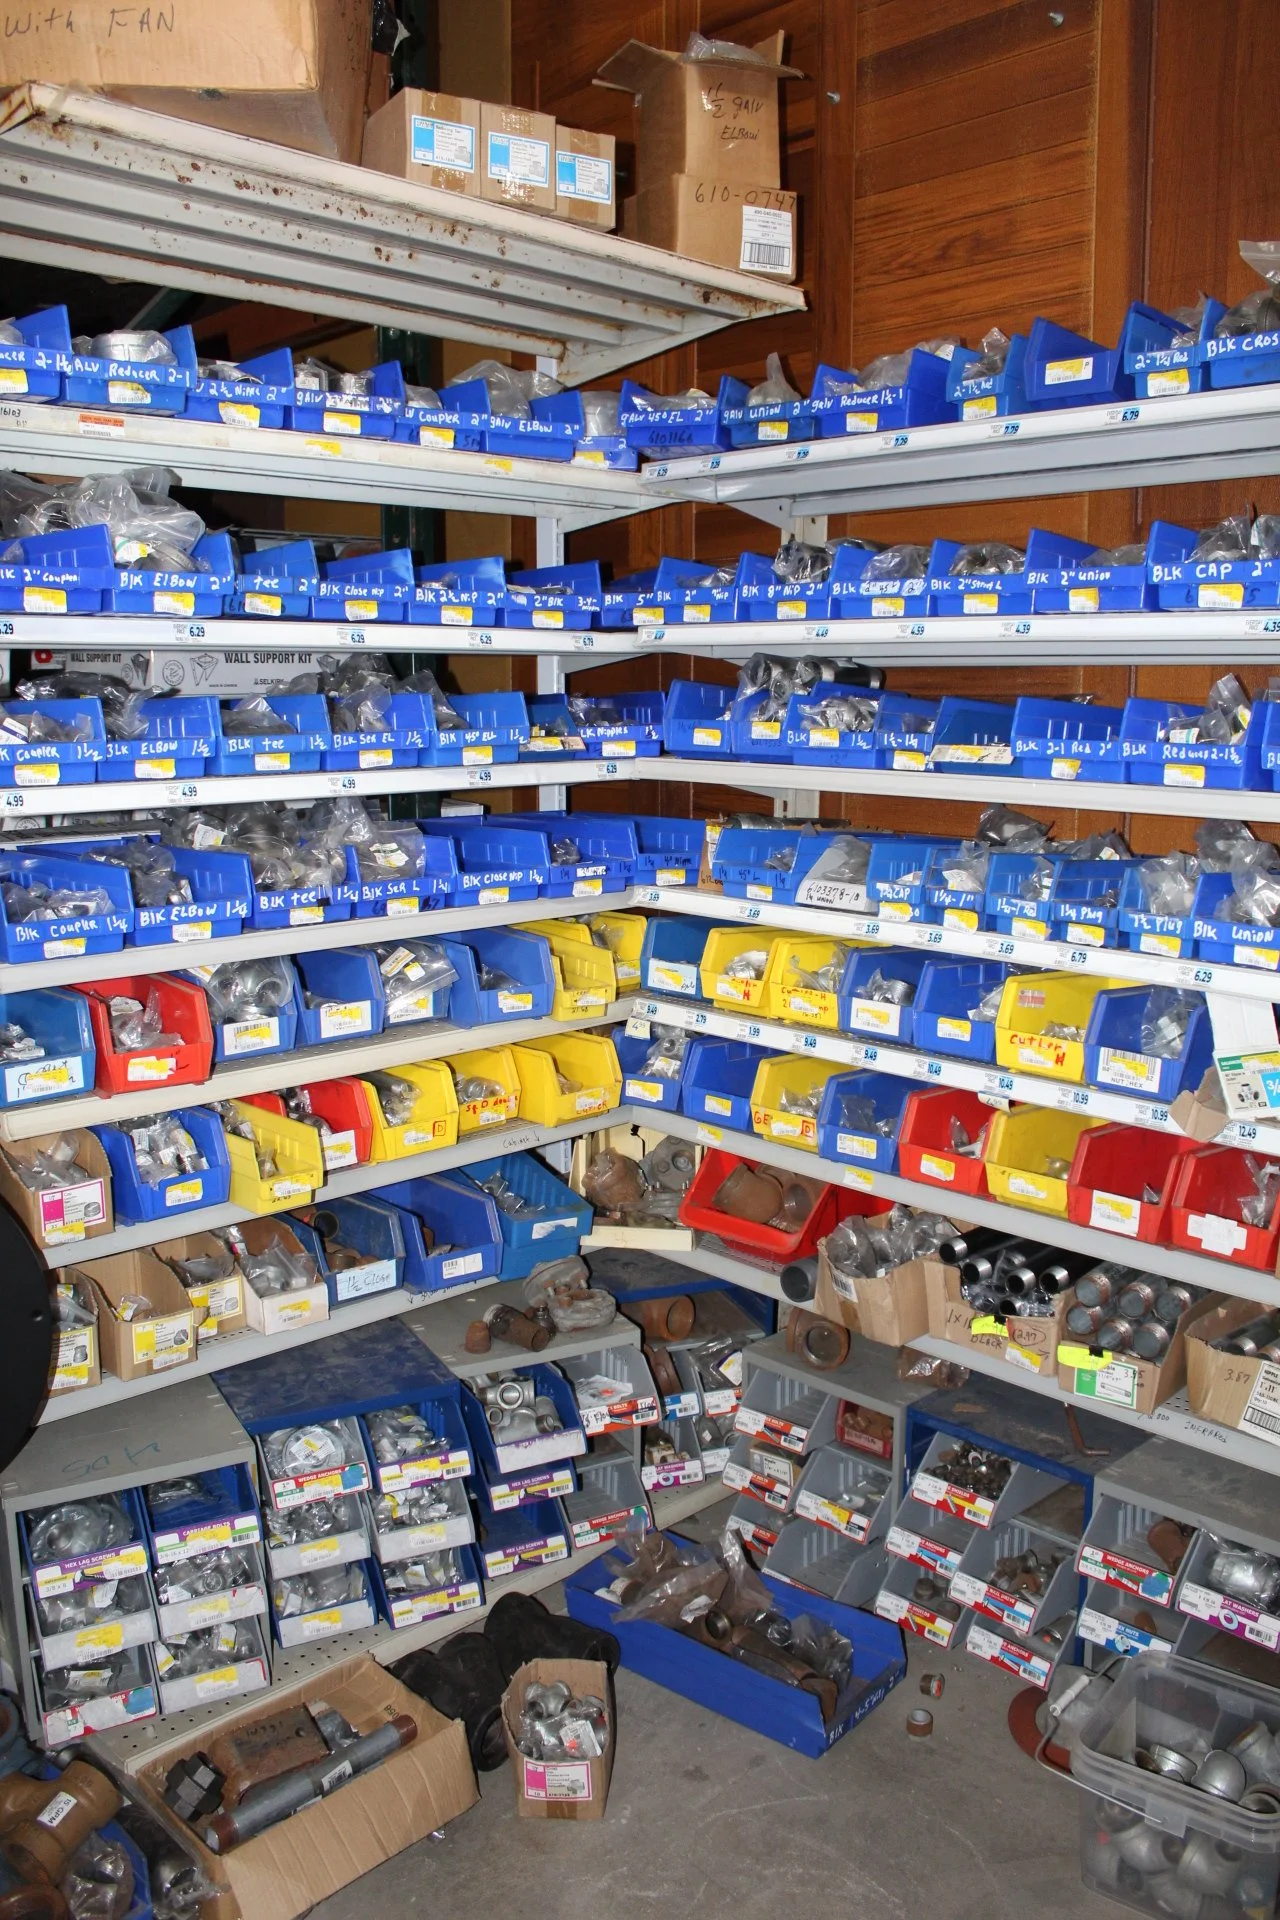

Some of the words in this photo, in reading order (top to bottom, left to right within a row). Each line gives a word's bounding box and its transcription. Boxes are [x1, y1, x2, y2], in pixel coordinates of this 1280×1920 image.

[4, 8, 75, 38] With
[108, 2, 176, 38] FAN
[1206, 338, 1237, 358] BLK
[1121, 409, 1139, 422] 6.79
[1196, 563, 1233, 579] CAP
[189, 626, 205, 637] 6.29
[816, 627, 828, 638] 4.49
[911, 625, 925, 636] 4.59
[1016, 623, 1031, 634] 4.39
[1263, 622, 1280, 632] 4.39
[351, 633, 365, 644] 6.29
[479, 634, 492, 645] 6.29
[70, 652, 84, 662] WALL
[86, 652, 111, 663] SUPPORT
[112, 653, 121, 663] KIT
[224, 652, 251, 664] WALL
[254, 652, 295, 664] SUPPORT
[298, 653, 312, 664] KIT
[787, 731, 807, 744] BLK
[1016, 740, 1038, 753] BLK
[1123, 742, 1146, 756] BLK
[479, 771, 491, 782] 4.99
[342, 777, 356, 790] 4.99
[182, 785, 197, 797] 4.99
[6, 794, 23, 807] 4.99
[748, 908, 760, 918] 3.69
[866, 924, 879, 935] 3.69
[928, 932, 941, 943] 3.69
[998, 943, 1014, 954] 3.69
[1071, 952, 1087, 963] 6.79
[1194, 971, 1212, 983] 6.29
[743, 990, 750, 1001] H
[749, 1026, 760, 1037] 1.99
[804, 1037, 817, 1048] 9.49
[864, 1049, 877, 1061] 9.49
[1055, 1053, 1065, 1066] H
[928, 1063, 941, 1076] 10.49
[999, 1077, 1013, 1090] 10.49
[1073, 1092, 1088, 1105] 10.99
[754, 1111, 769, 1125] GE
[1151, 1108, 1167, 1122] 10.99
[1239, 1126, 1256, 1139] 12.49
[317, 1469, 341, 1479] ANCHORS
[532, 1474, 550, 1484] SCREWS
[182, 1526, 209, 1536] CARRIAGE
[526, 1541, 544, 1550] SCREWS
[65, 1560, 78, 1568] HEX
[80, 1557, 92, 1566] LAG
[93, 1553, 116, 1564] SCREWS
[1106, 1556, 1125, 1566] WEDGE
[1126, 1561, 1149, 1575] ANCHORS
[1237, 1603, 1260, 1617] WASHERS
[1126, 1629, 1139, 1637] NUTS
[48, 1808, 64, 1824] GPM
